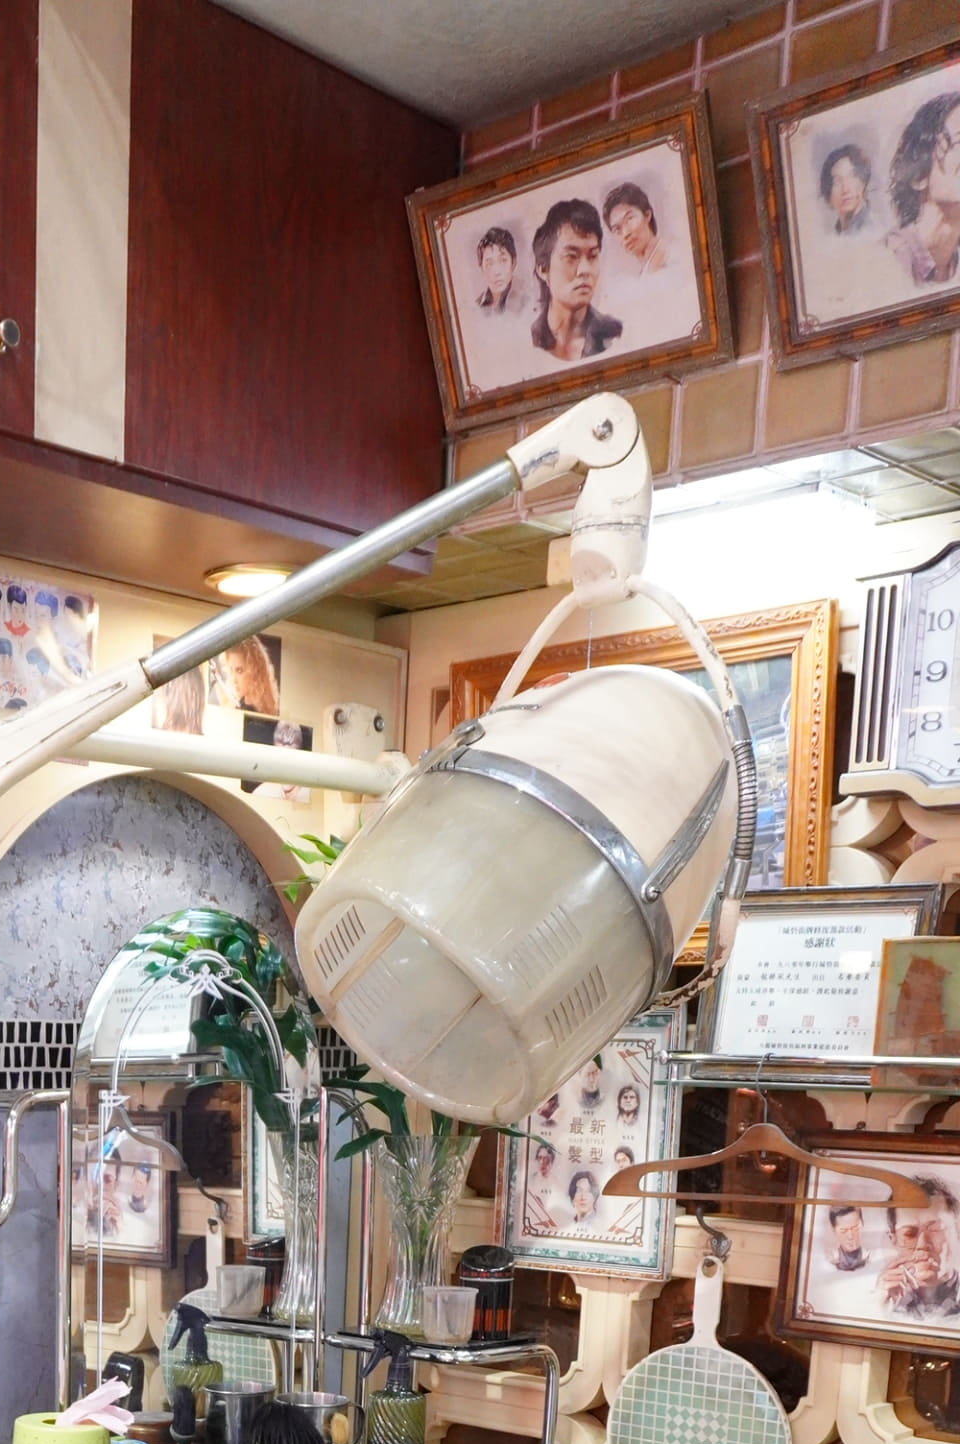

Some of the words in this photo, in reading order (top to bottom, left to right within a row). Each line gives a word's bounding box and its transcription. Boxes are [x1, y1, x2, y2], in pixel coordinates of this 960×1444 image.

[927, 609, 954, 632] 10
[926, 660, 948, 682] 9
[920, 711, 942, 732] 8
[568, 1117, 606, 1136] 最新
[568, 1146, 604, 1164] 髮型
